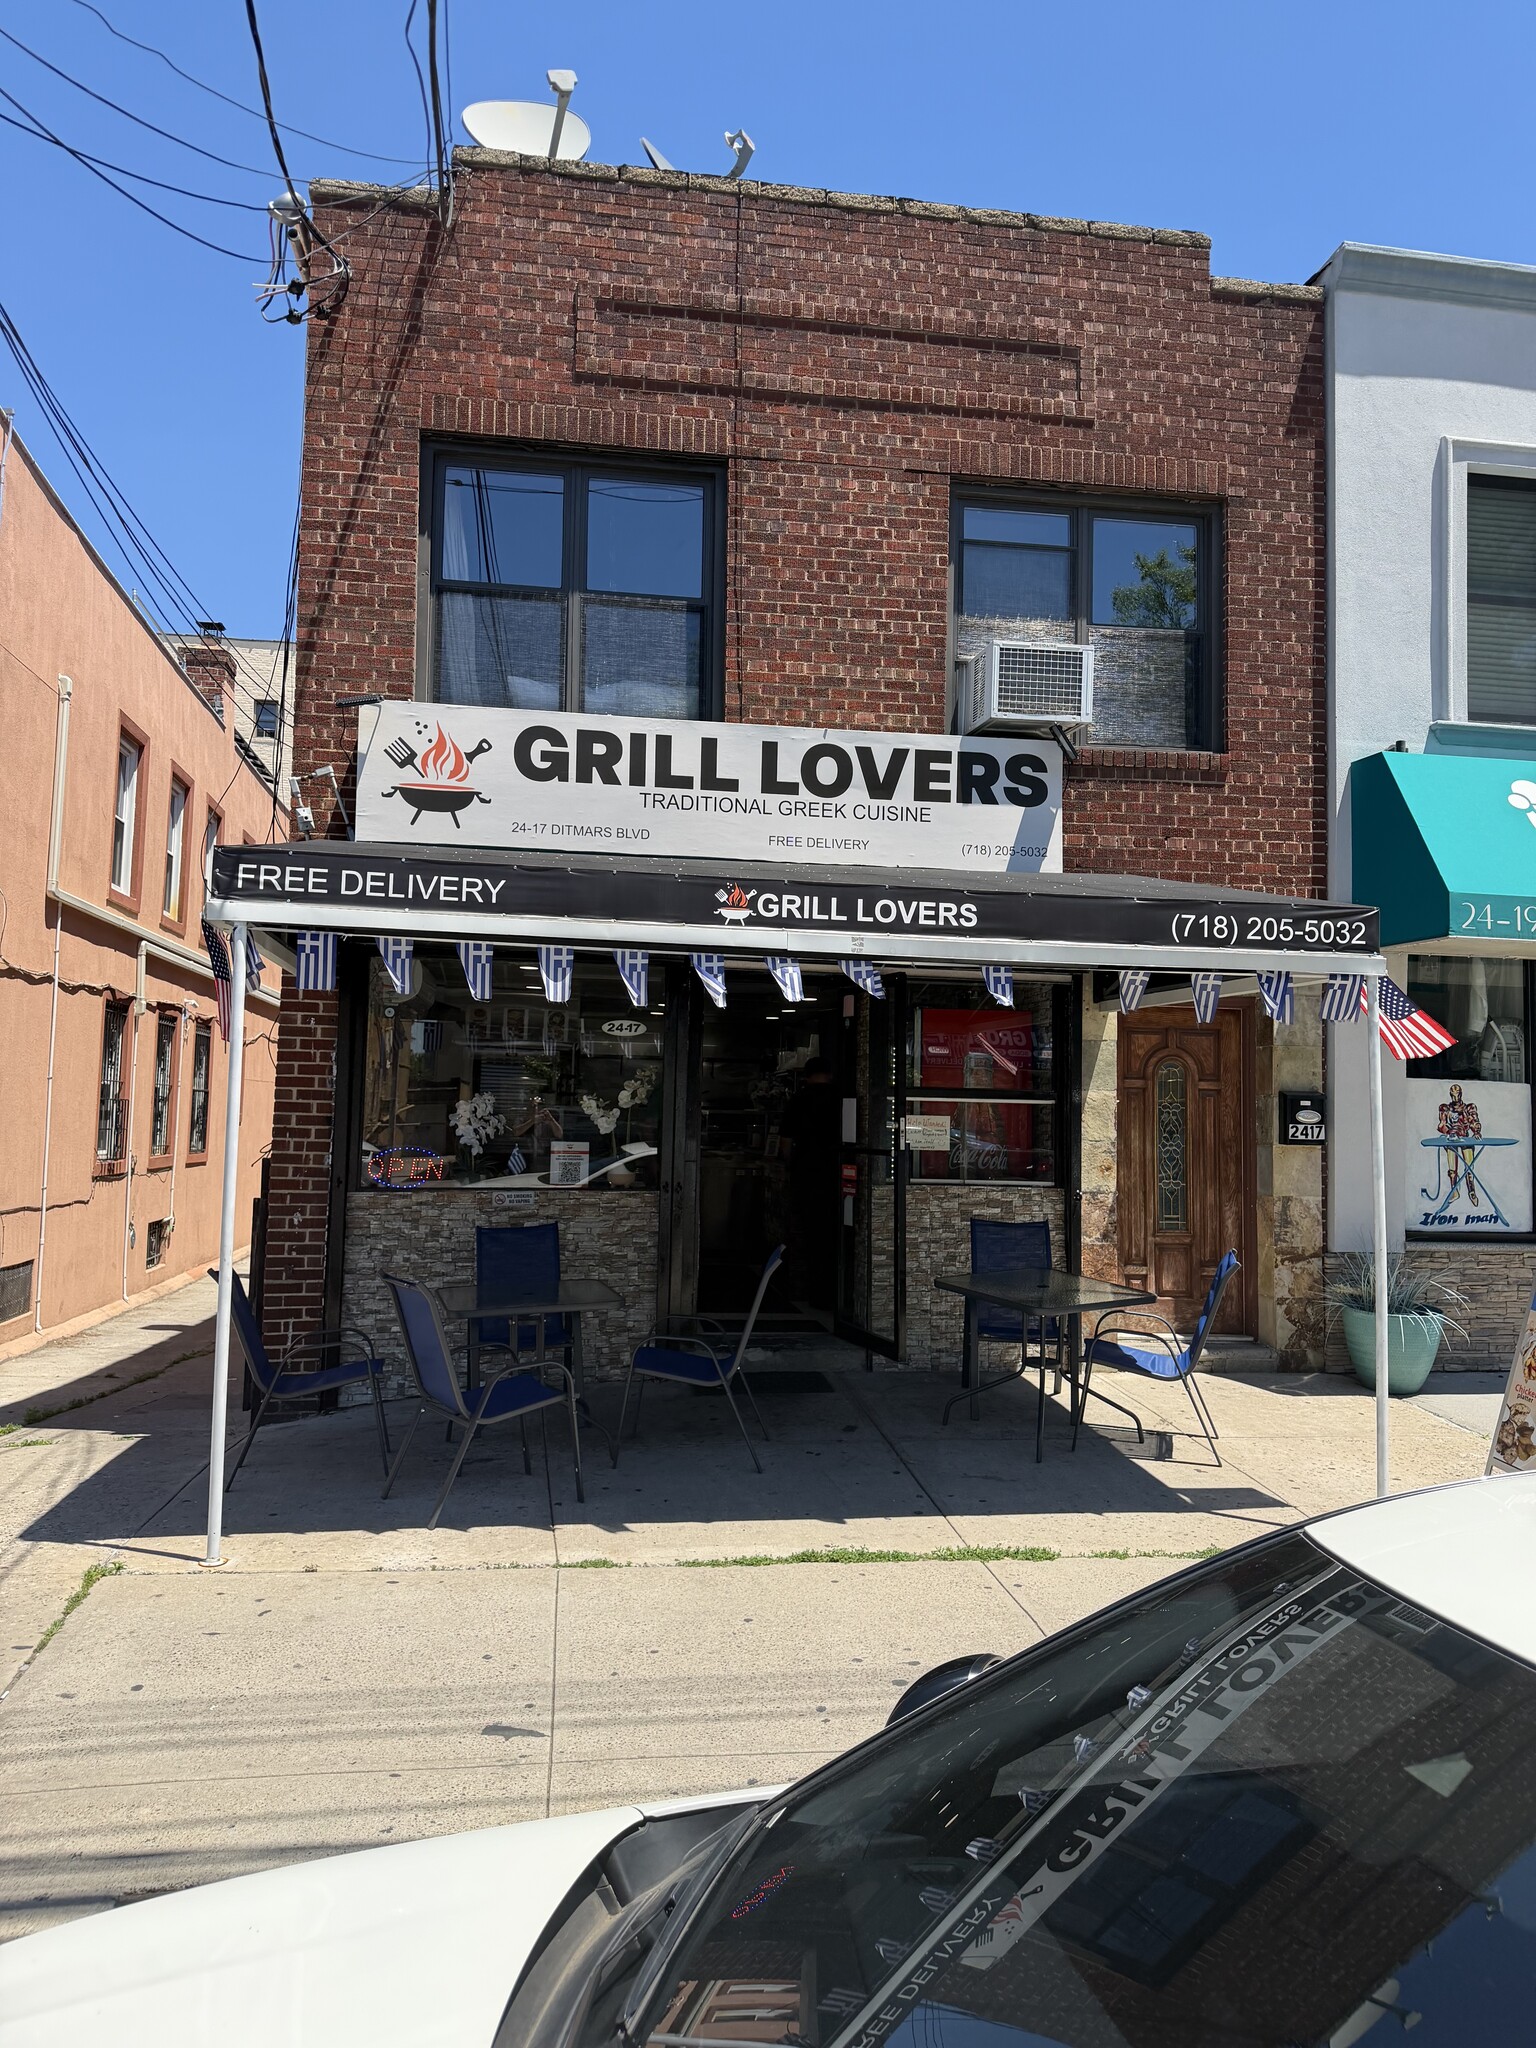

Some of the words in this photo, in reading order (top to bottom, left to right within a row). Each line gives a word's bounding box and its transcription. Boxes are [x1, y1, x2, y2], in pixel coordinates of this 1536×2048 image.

[513, 724, 739, 793] GRILL
[761, 740, 1049, 808] LOVERS
[639, 792, 773, 815] TRADITIONAL
[778, 800, 847, 819] GREEK
[853, 804, 932, 823] CUISINE
[511, 822, 547, 836] 24-17
[551, 824, 612, 838] DITMARS
[616, 827, 650, 840] BLVD
[768, 835, 803, 847] FREE
[806, 837, 870, 850] DELIVERY
[961, 843, 992, 858] (718)
[994, 845, 1048, 858] 205-5032
[237, 863, 329, 894] FREE
[340, 869, 507, 904] DELIVERY
[757, 893, 848, 921] GRILL
[857, 898, 978, 928] LOVERS
[1171, 913, 1238, 945] (718)
[1246, 916, 1367, 945] 205-5032
[606, 1022, 641, 1033] 24-17
[1290, 1125, 1323, 1139] 2417
[367, 1157, 444, 1180] OPEN
[1419, 1212, 1459, 1226] Iron
[1464, 1213, 1499, 1226] man
